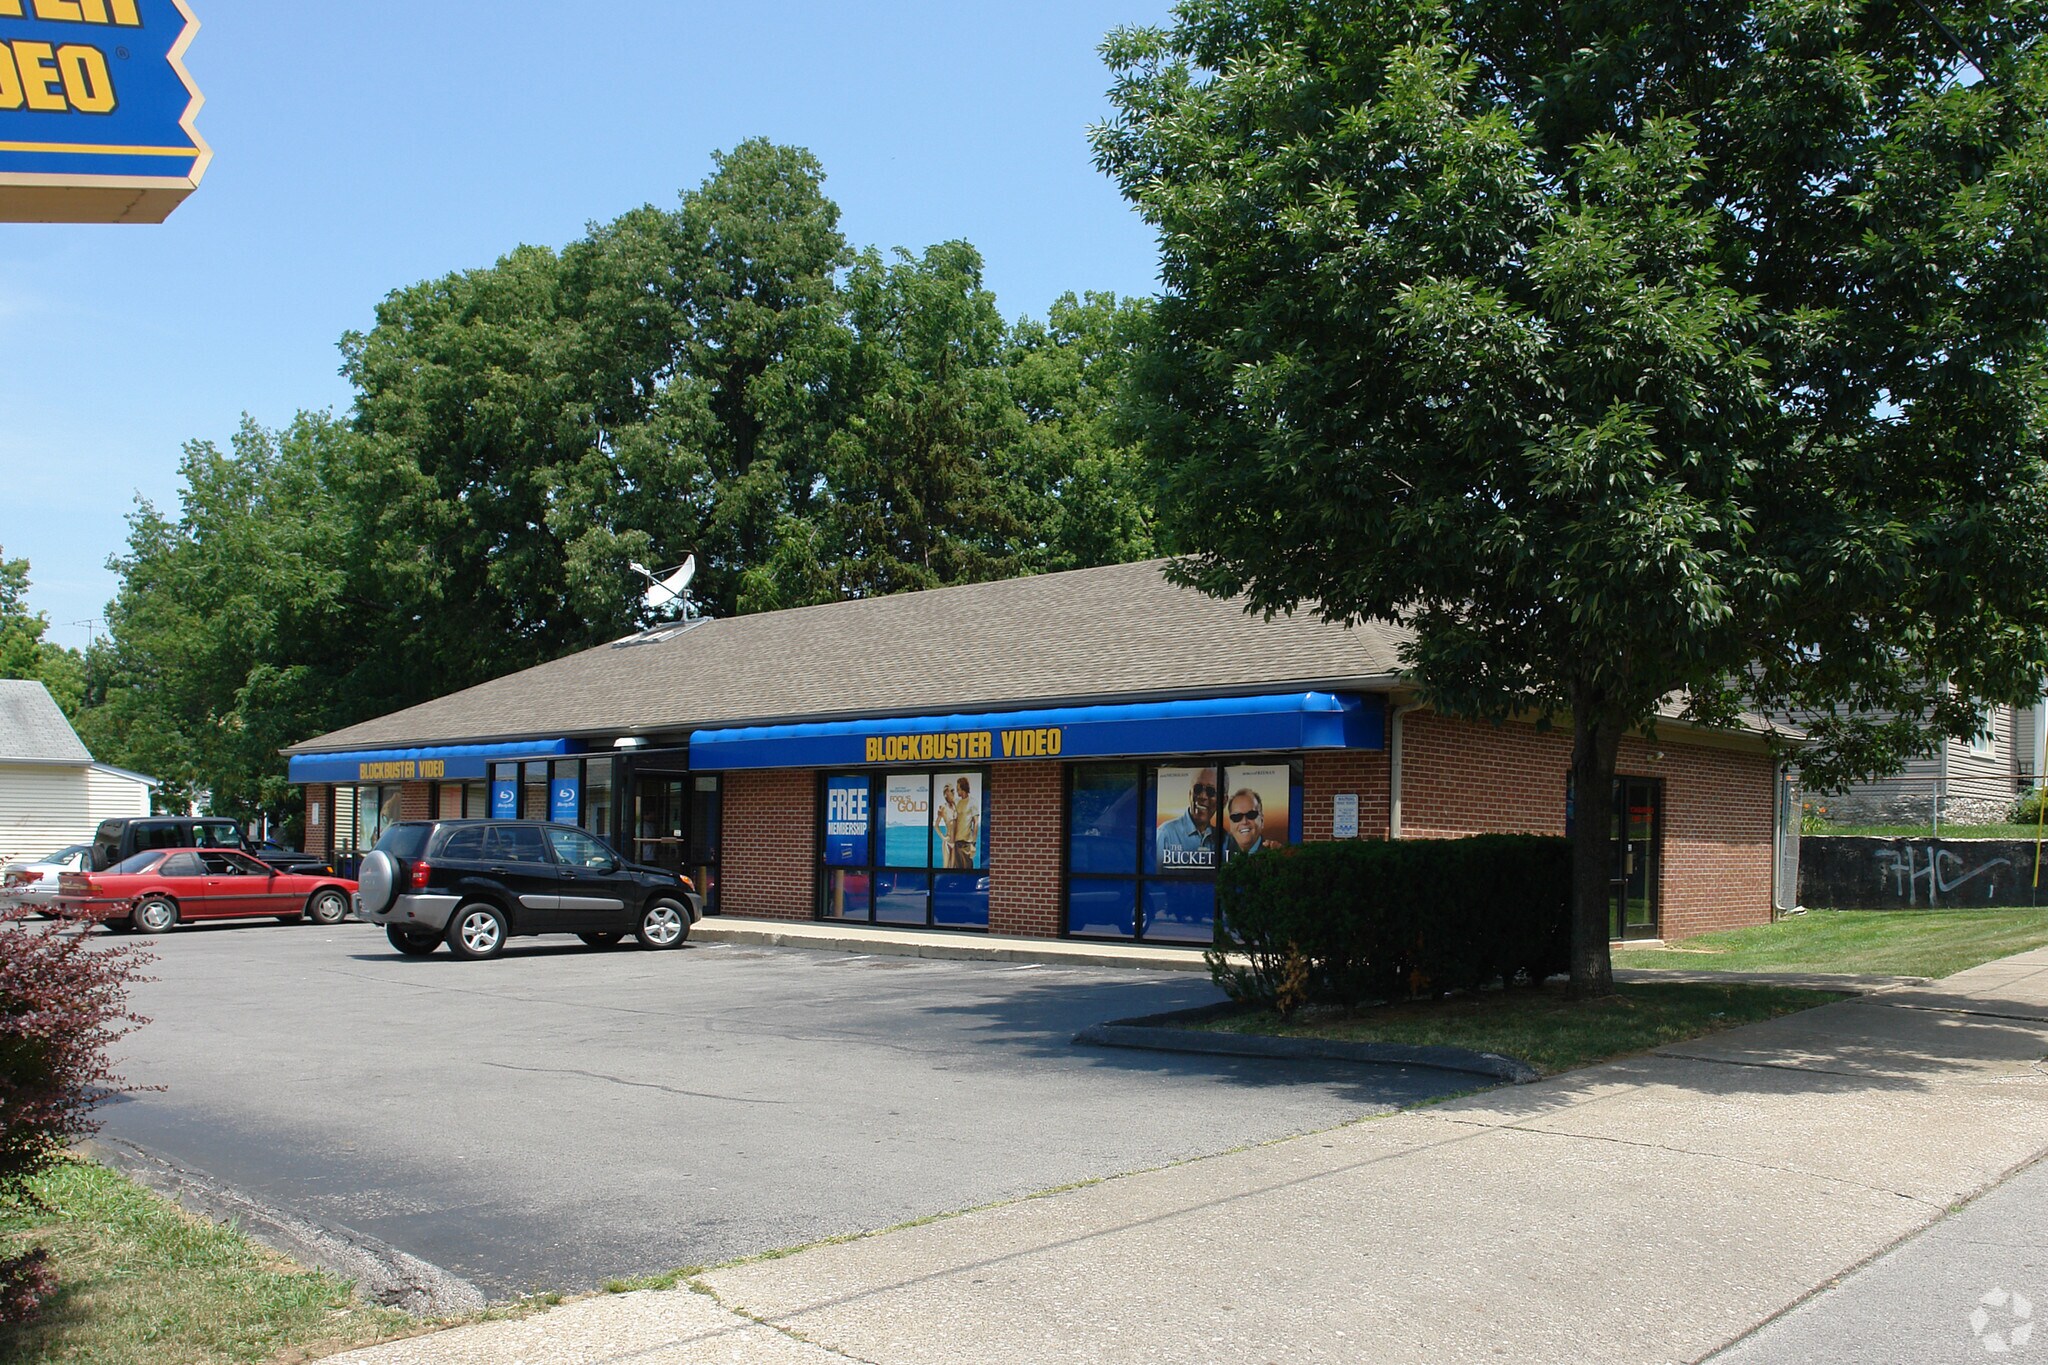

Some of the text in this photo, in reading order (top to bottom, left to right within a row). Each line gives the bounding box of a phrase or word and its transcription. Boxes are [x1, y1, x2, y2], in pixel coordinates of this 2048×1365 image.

[865, 727, 1062, 762] BLOCKBUSTER VIDEO
[359, 759, 445, 779] BLOCKBUSTER VIDEO
[828, 788, 867, 821] FREE
[897, 800, 928, 812] GOLD
[827, 822, 867, 836] MEMBERSHIP
[1162, 849, 1216, 865] BUCKET
